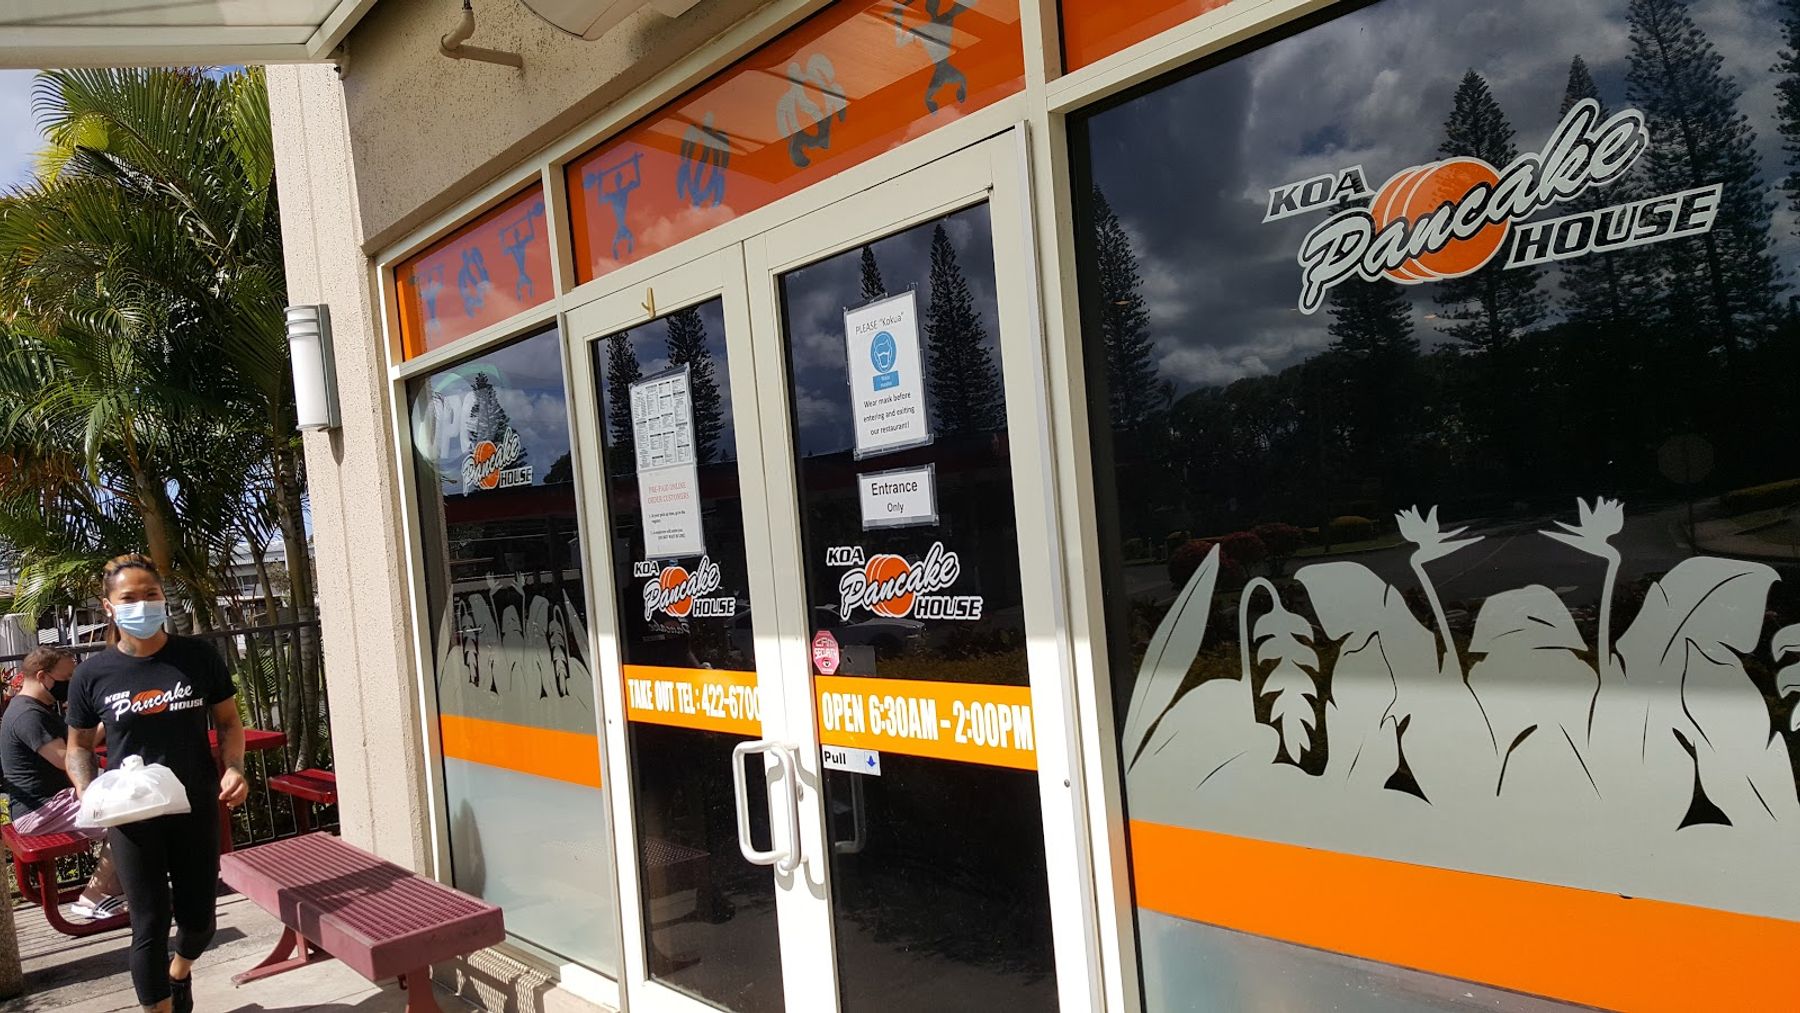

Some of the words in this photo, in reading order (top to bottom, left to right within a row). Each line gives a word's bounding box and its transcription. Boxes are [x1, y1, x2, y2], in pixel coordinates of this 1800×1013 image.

[1264, 165, 1374, 222] KOA
[1298, 98, 1649, 314] Pancake
[1503, 184, 1723, 270] HOUSE
[856, 319, 878, 335] PLEASE
[878, 395, 892, 405] mask
[892, 392, 911, 402] before
[863, 412, 885, 423] entering
[885, 409, 896, 418] and
[896, 406, 916, 415] exiting
[870, 427, 879, 436] our
[462, 427, 520, 497] Pancake
[499, 466, 532, 488] HOUSE
[871, 481, 918, 496] Entrance
[887, 501, 904, 513] Only
[826, 546, 865, 566] KOA
[634, 561, 660, 577] KOA
[643, 555, 720, 621] Pancake
[839, 541, 960, 621] Pancake
[693, 597, 735, 617] HOUSE
[914, 596, 983, 620] HOUSE
[112, 681, 193, 721] Pancake
[627, 679, 654, 710] TAKE
[654, 680, 675, 713] OUT
[821, 691, 865, 733] OPEN
[868, 694, 939, 741] 6:30AM
[952, 700, 1034, 751] 2:00PM
[823, 750, 846, 765] Pull
